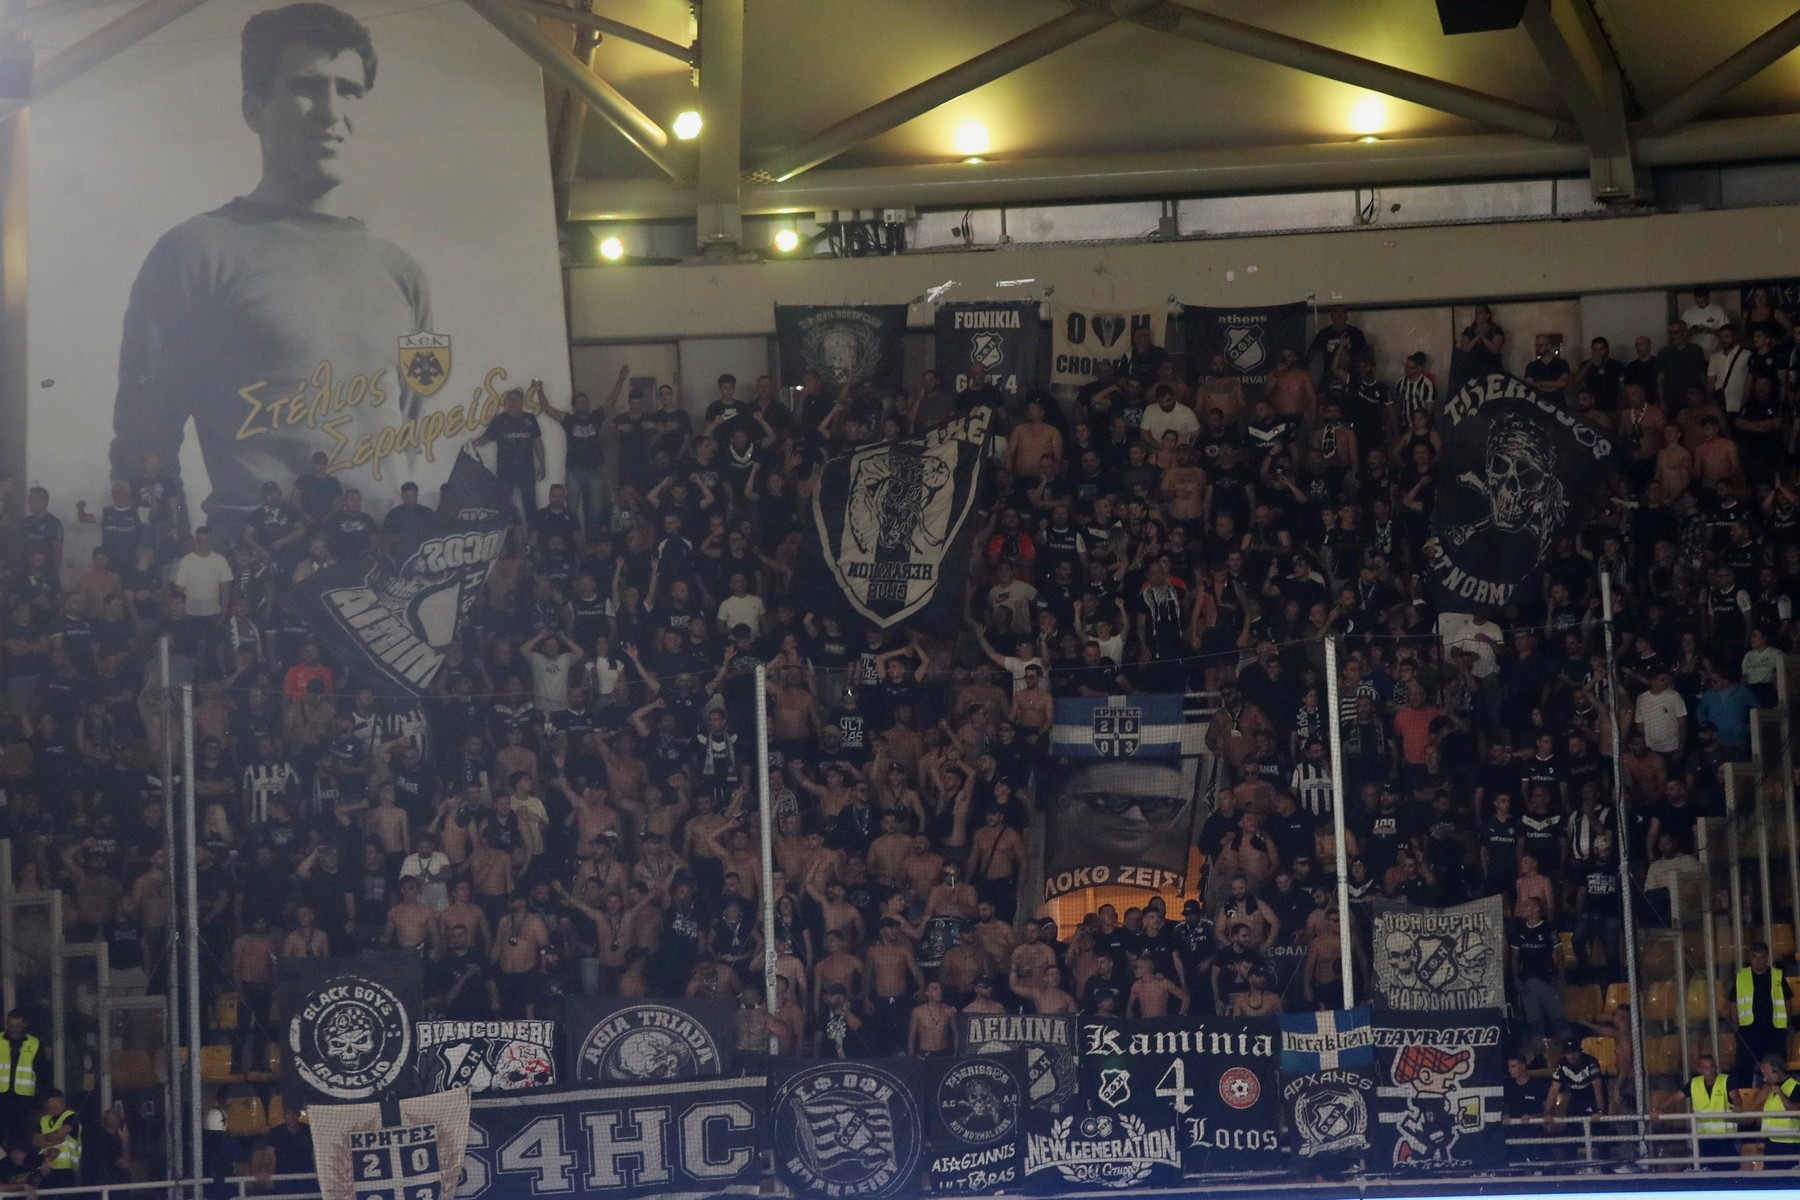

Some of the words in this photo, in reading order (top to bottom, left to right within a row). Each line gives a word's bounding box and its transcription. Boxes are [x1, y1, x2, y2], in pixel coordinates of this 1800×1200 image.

[954, 311, 1020, 329] FOINIKIA
[1218, 314, 1268, 324] athens
[1005, 373, 1018, 394] 4
[235, 360, 387, 440] Στέλιος
[321, 367, 542, 480] Σεραφείδς
[1094, 708, 1140, 718] ΚΡΗΤΕΣ
[1100, 720, 1109, 732] 2
[1125, 720, 1133, 732] 0
[1101, 741, 1109, 754] 0
[1125, 740, 1133, 754] 3
[303, 985, 351, 1021] BLACK
[355, 986, 393, 1016] BOYS
[417, 1020, 555, 1053] BIANCONERI
[585, 1016, 631, 1065] AGIA
[637, 1011, 714, 1065] TRIADA
[1084, 1024, 1273, 1057] Kaminia
[1155, 1057, 1194, 1114] 4
[351, 1125, 437, 1148] ΚΡΗΤΕΣ
[950, 1120, 965, 1135] NOT
[963, 1129, 995, 1141] NORMAL
[1071, 1126, 1177, 1160] GENERATION
[1185, 1117, 1279, 1151] Locos
[362, 1153, 382, 1178] 2
[411, 1147, 429, 1172] 0
